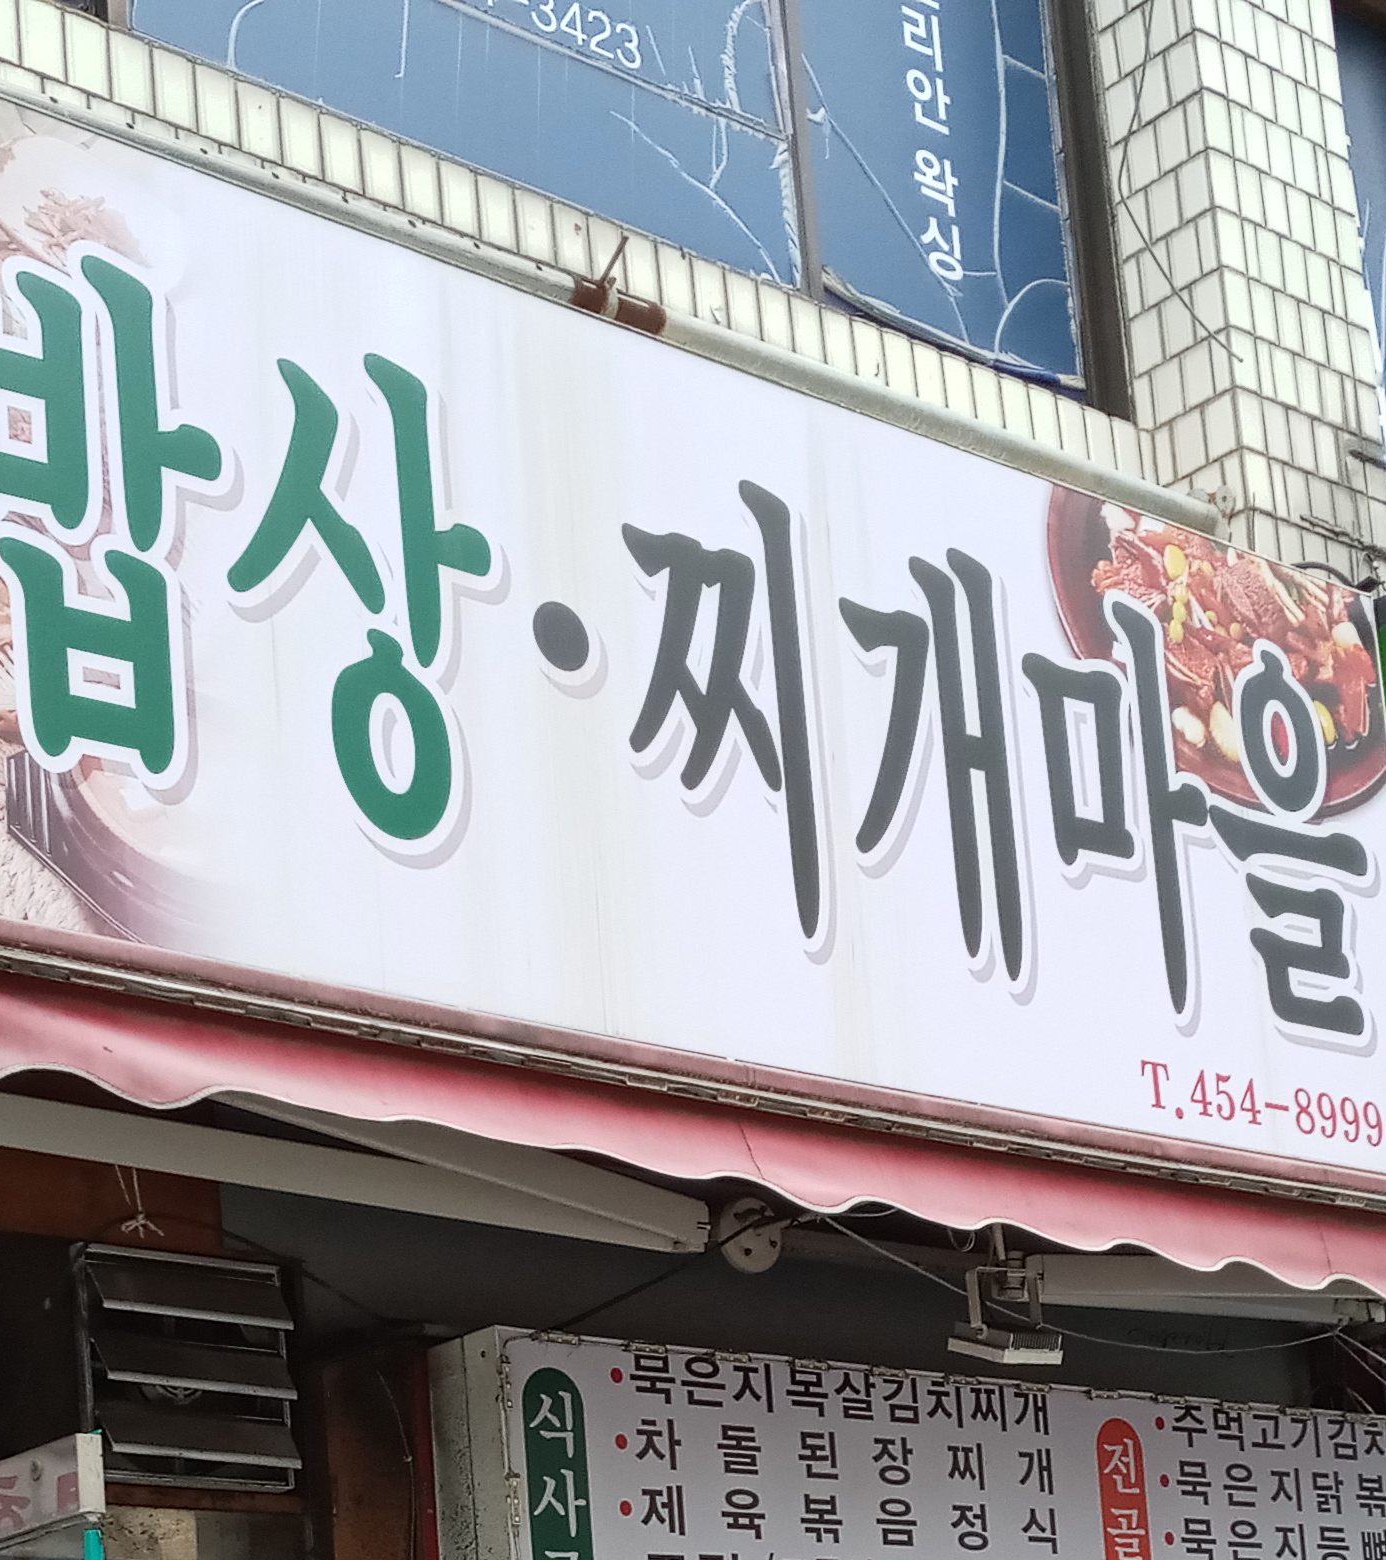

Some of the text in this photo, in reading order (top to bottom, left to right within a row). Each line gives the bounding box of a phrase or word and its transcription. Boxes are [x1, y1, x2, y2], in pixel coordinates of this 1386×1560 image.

[901, 0, 964, 281] 리안 왁싱
[1139, 1056, 1385, 1149] T.454-8999
